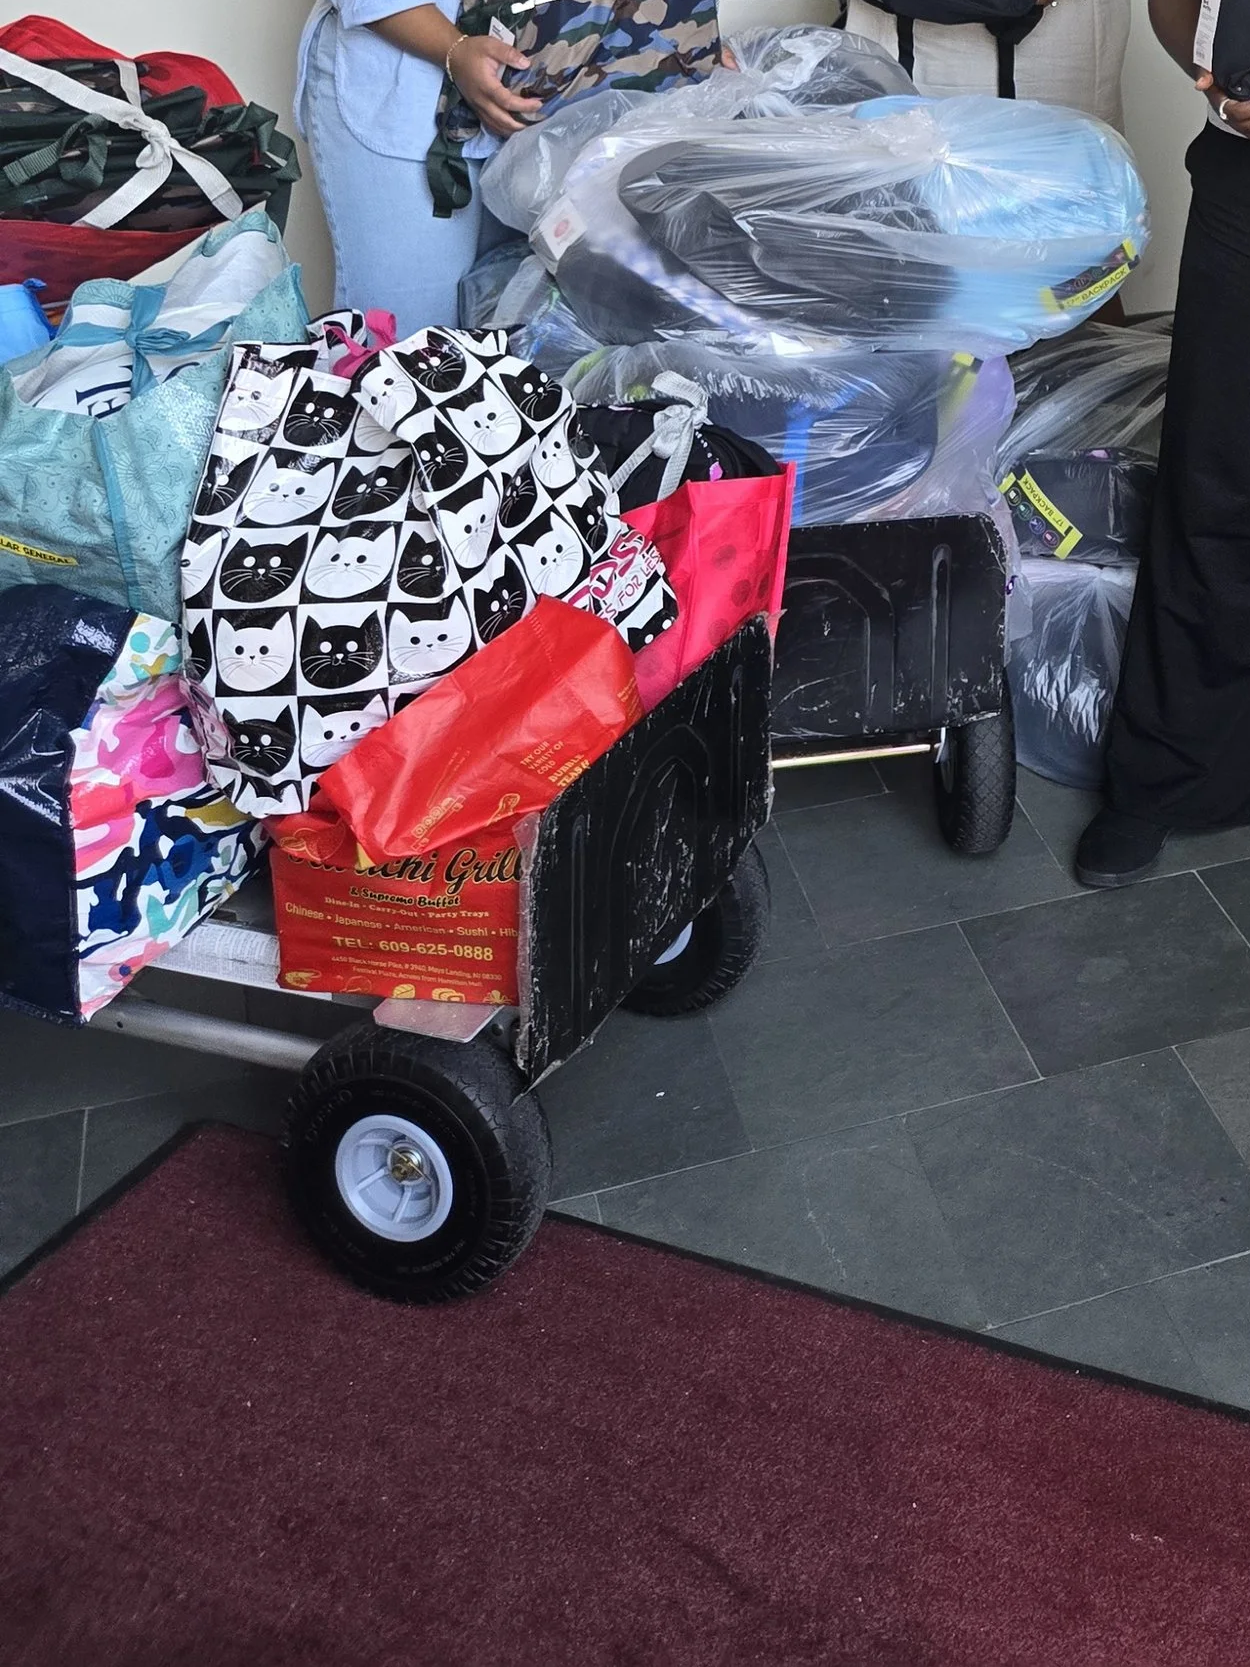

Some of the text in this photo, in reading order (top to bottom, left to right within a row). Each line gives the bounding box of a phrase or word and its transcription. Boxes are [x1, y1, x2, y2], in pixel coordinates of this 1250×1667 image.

[1081, 267, 1128, 301] BACKPACK
[1022, 477, 1055, 517] BACKPACK
[22, 547, 70, 563] GENERAL
[617, 575, 643, 607] FOR
[520, 740, 550, 766] TRY OUR
[537, 760, 556, 774] COLD
[547, 754, 585, 783] BUBBLE
[325, 897, 360, 908] Dine-In
[369, 904, 418, 917] Carry-Out
[428, 911, 458, 919] Party
[349, 885, 461, 909] & Supreme Buffet
[285, 901, 325, 920] Chinese
[334, 914, 383, 929] Japanese
[393, 922, 446, 934] American
[456, 926, 488, 936] Sushi
[331, 936, 494, 961] TEL: 609-625-0888
